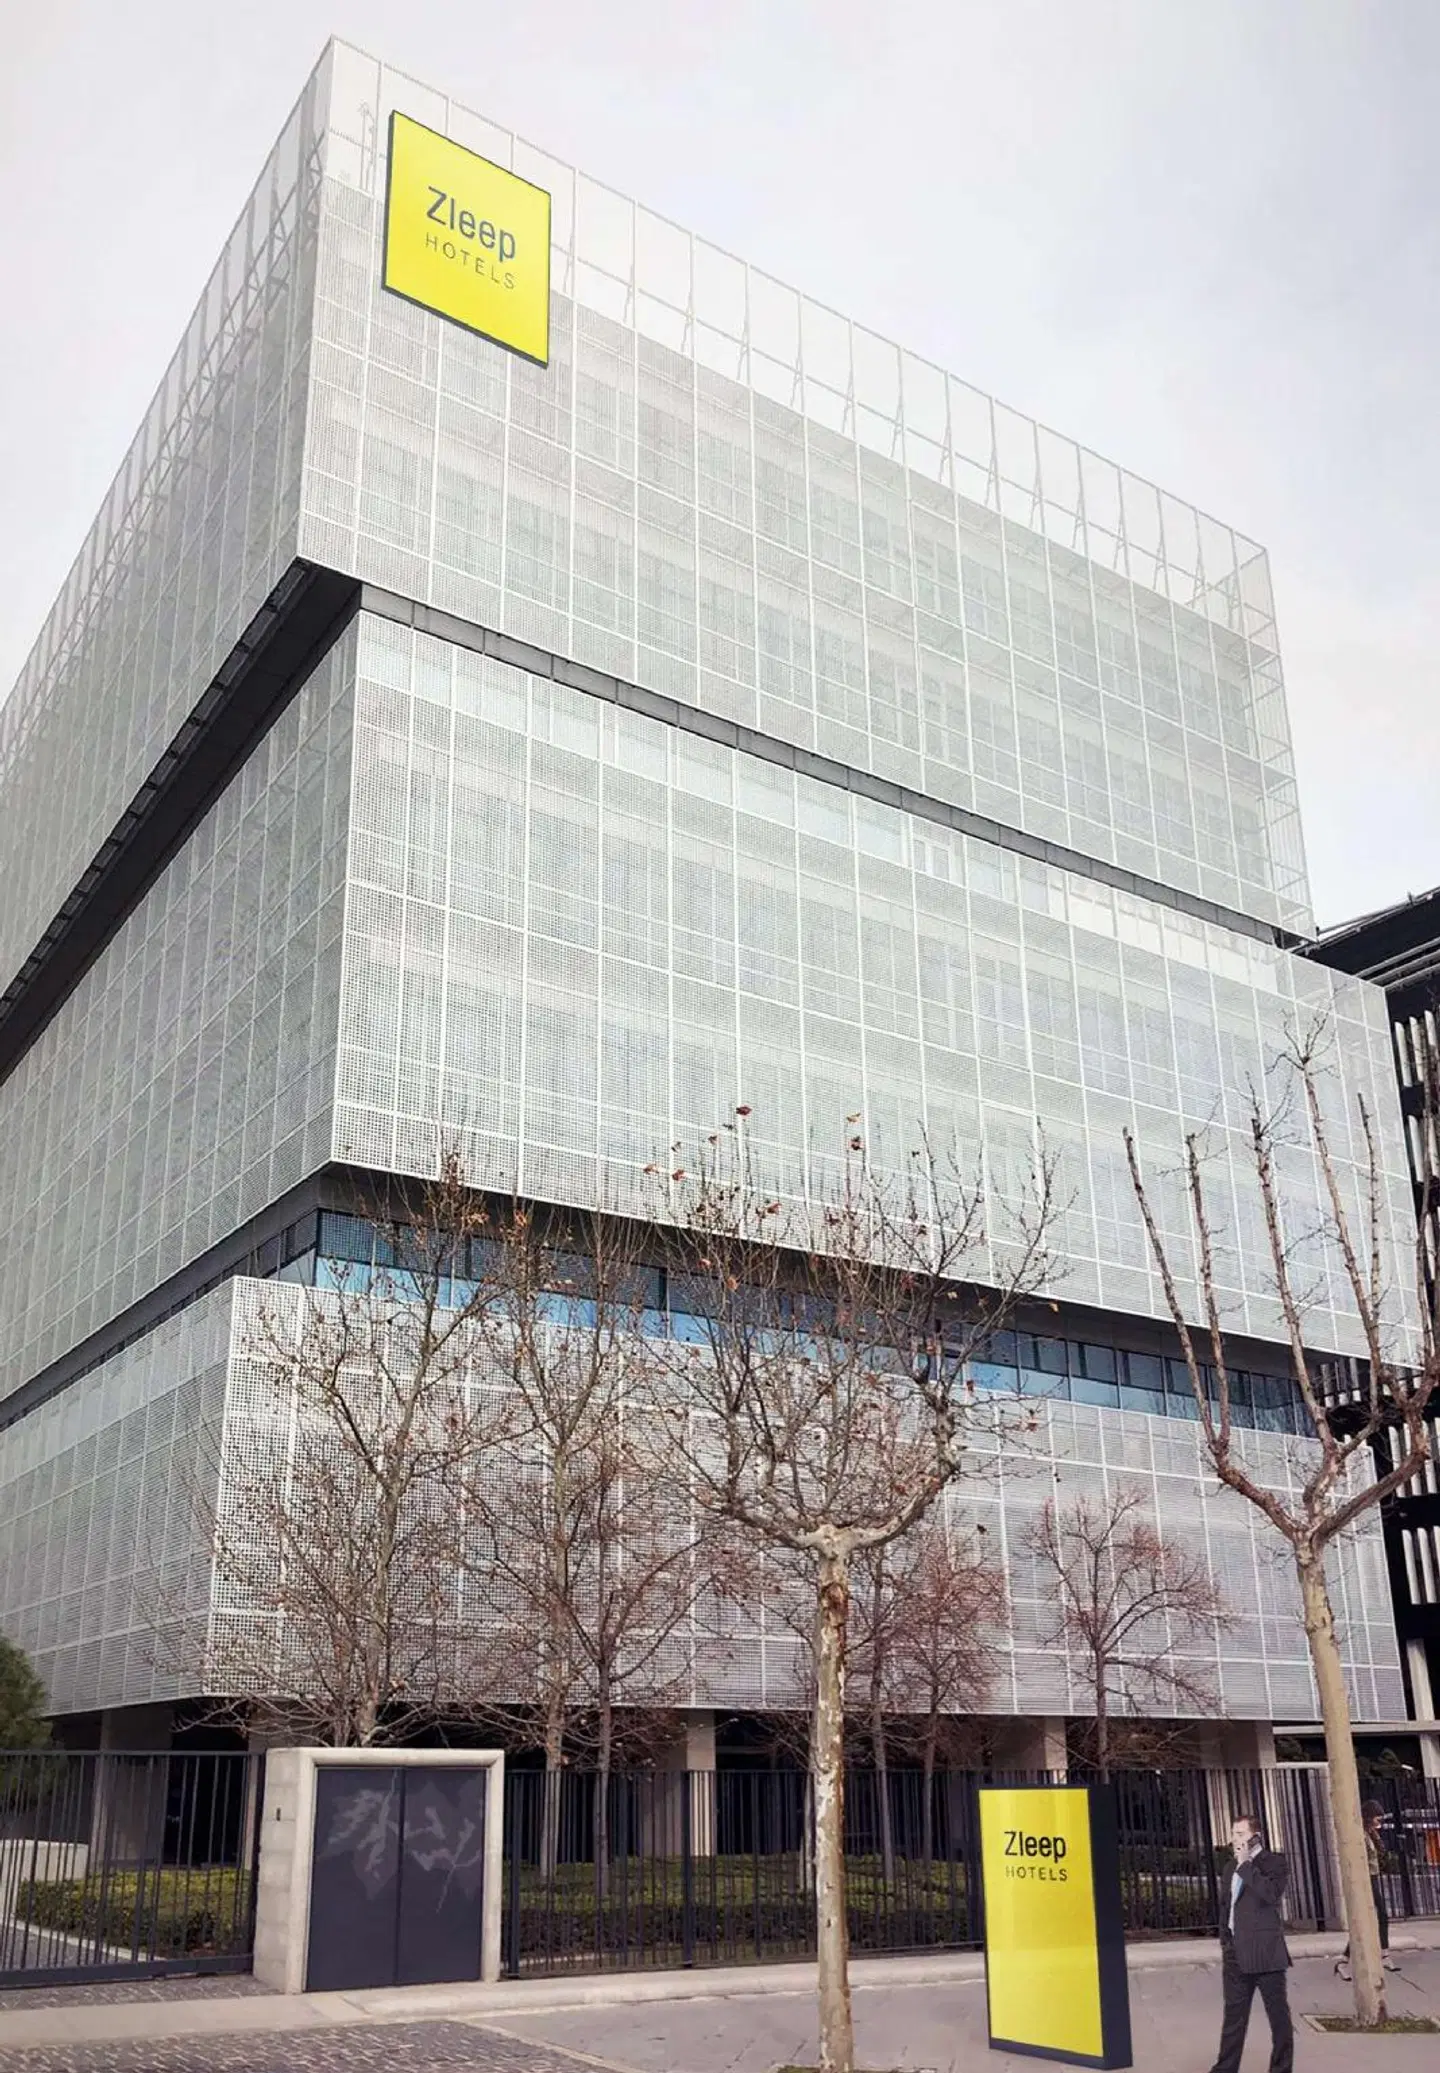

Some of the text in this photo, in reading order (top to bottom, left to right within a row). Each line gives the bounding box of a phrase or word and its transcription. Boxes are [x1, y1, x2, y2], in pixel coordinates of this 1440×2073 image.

[426, 186, 516, 262] Zleep
[426, 234, 515, 290] HOTELS
[1005, 1831, 1066, 1863] Zleep
[1006, 1866, 1067, 1881] HOTELS
